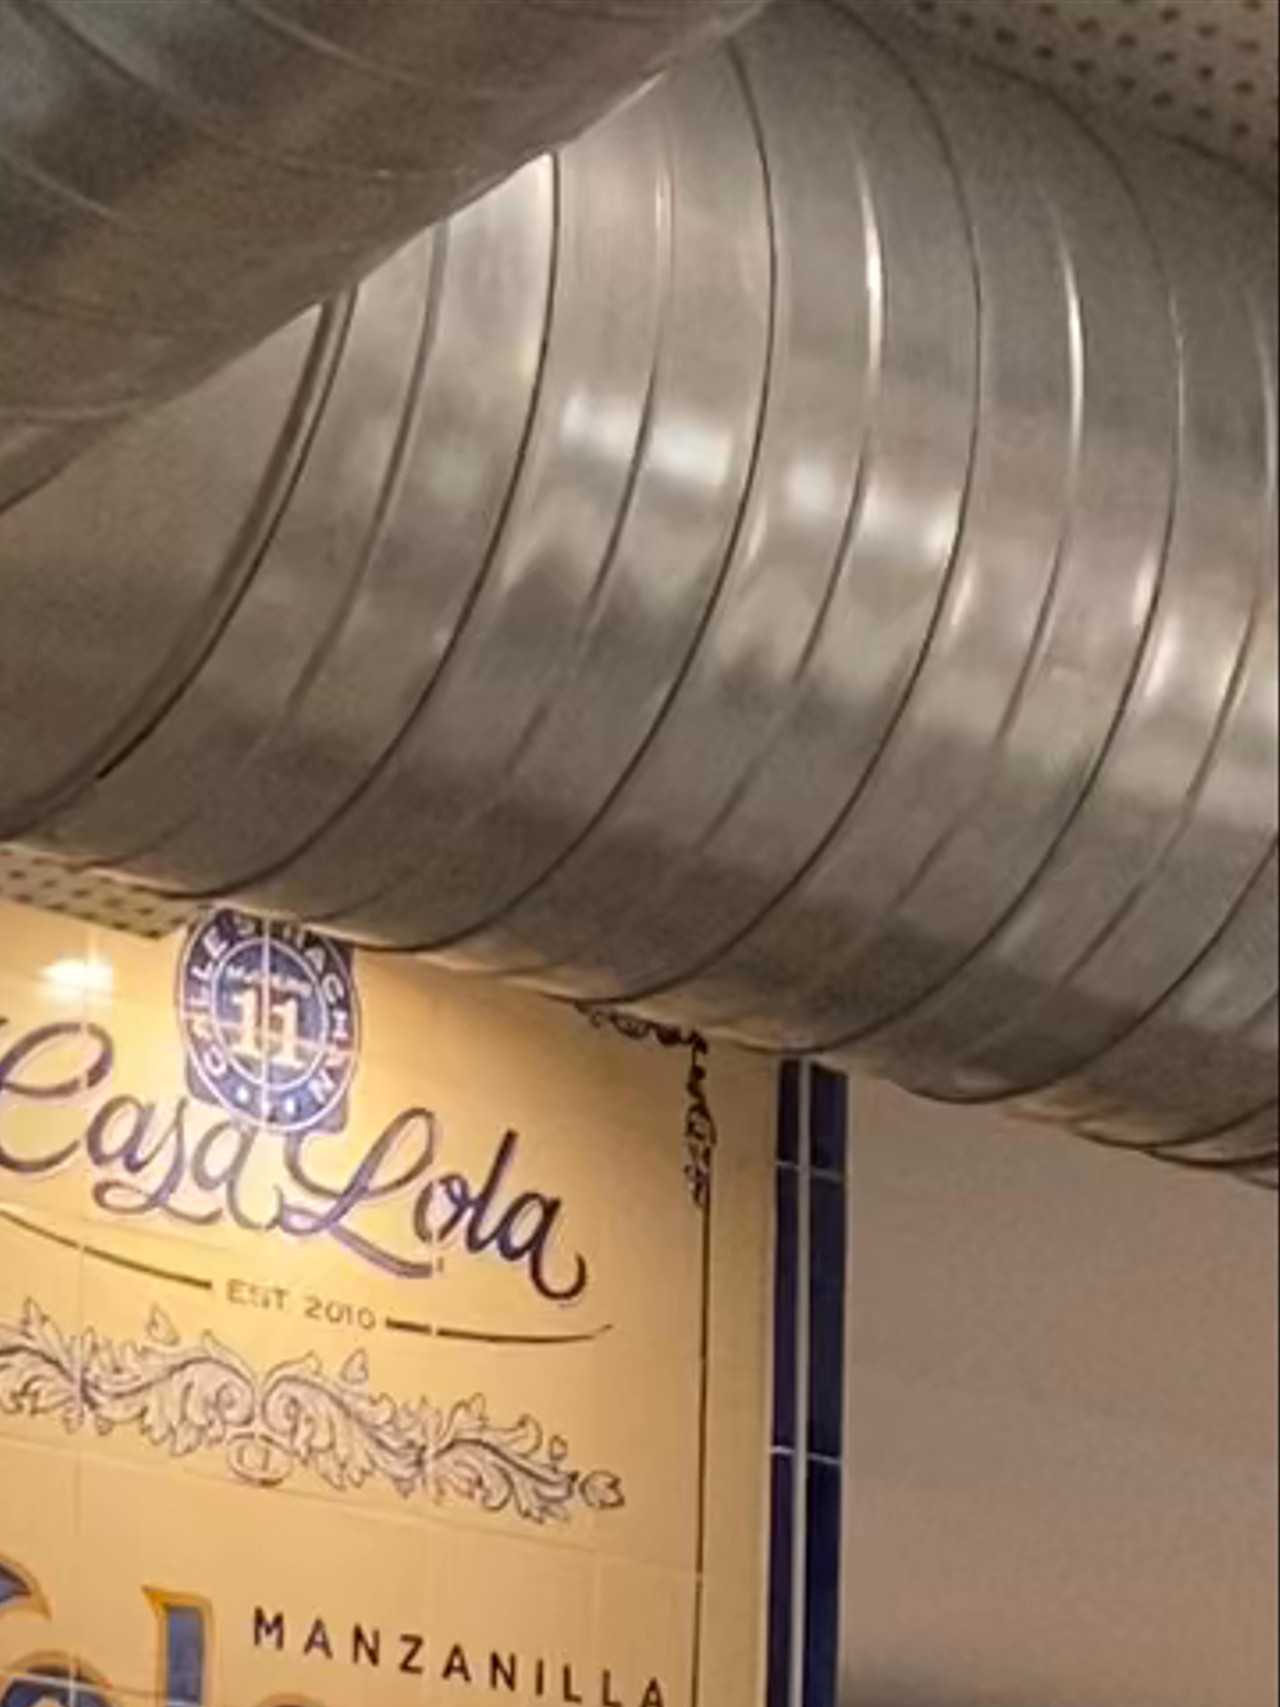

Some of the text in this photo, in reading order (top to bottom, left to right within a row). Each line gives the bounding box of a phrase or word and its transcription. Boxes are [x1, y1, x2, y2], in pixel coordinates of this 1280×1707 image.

[232, 988, 306, 1070] 11
[275, 1106, 587, 1301] Lola
[304, 1296, 377, 1330] 2010
